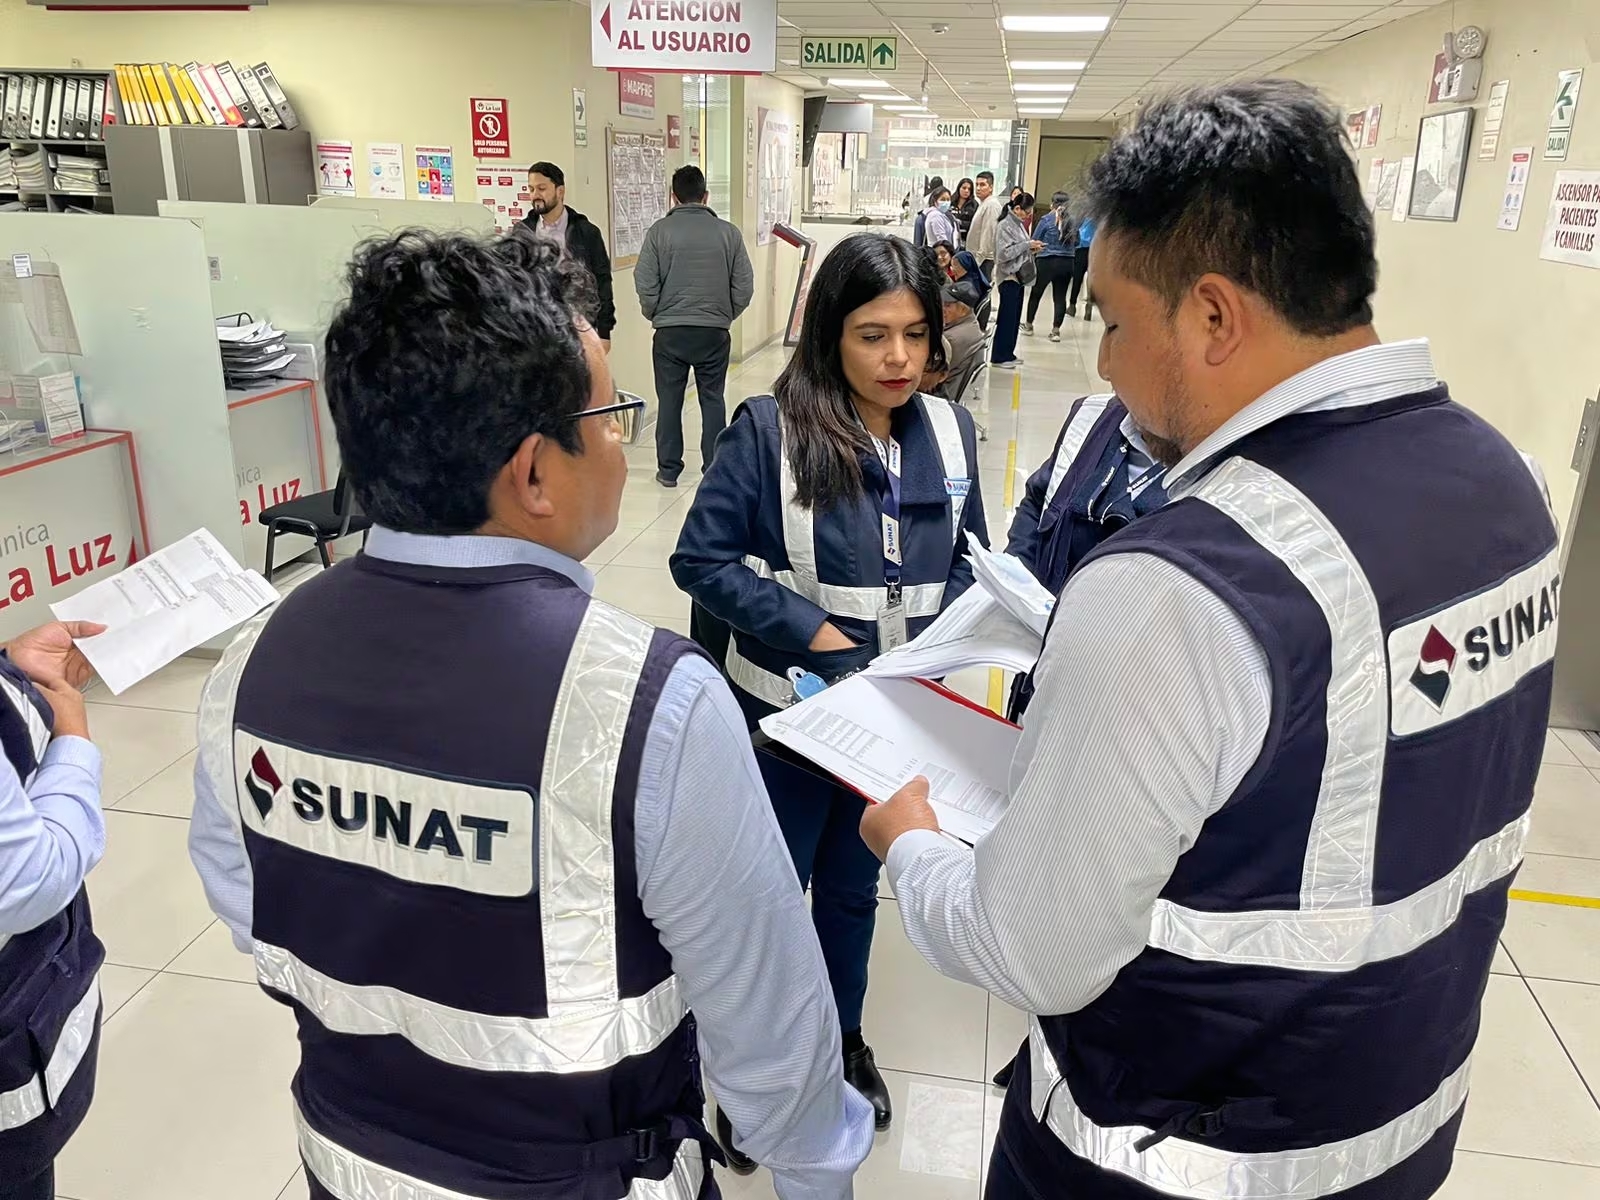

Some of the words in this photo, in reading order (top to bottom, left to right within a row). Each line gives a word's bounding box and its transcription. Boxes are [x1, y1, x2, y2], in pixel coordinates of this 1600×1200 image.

[617, 30, 645, 50] AL
[652, 31, 751, 53] USUARIO
[804, 42, 865, 64] SALIDA
[627, 79, 653, 98] MAPFRE
[937, 124, 971, 137] SALIDA
[1547, 137, 1566, 151] SALIDA
[1555, 183, 1593, 203] ASCENSOR
[1560, 207, 1598, 228] PACIENTES
[45, 534, 116, 587] Luz
[1464, 574, 1560, 672] SUNAT
[292, 777, 509, 864] SUNAT
